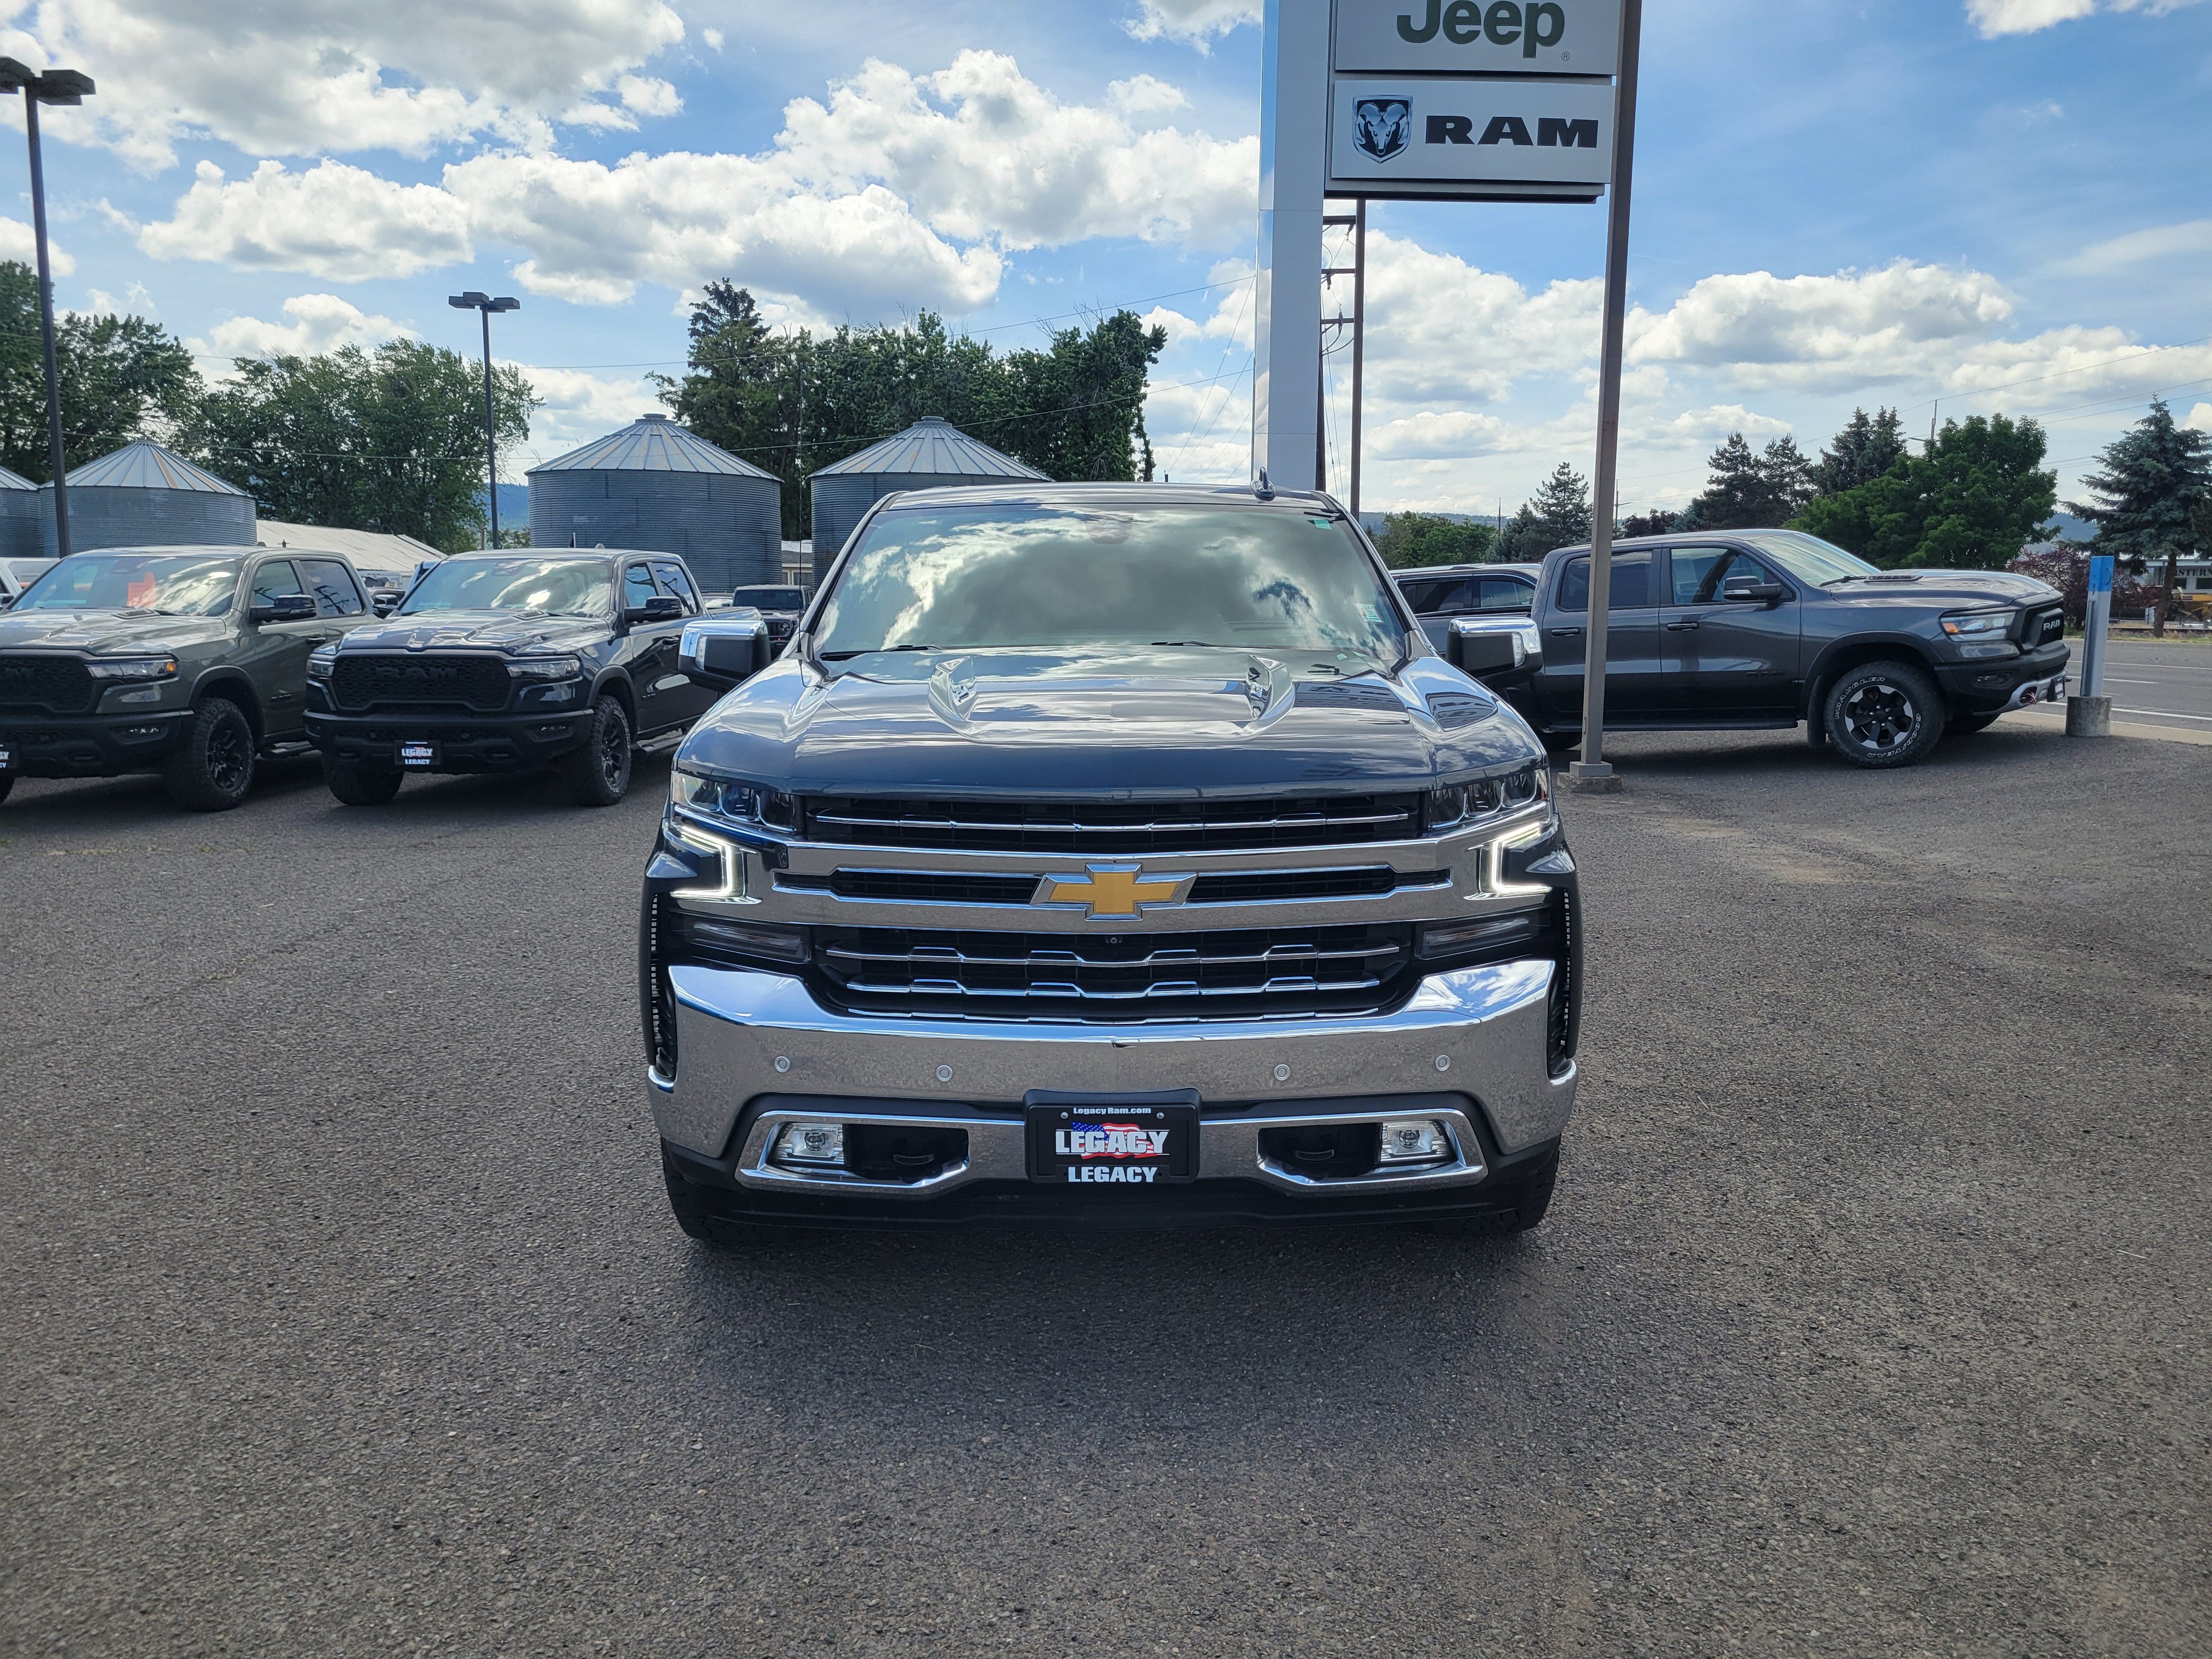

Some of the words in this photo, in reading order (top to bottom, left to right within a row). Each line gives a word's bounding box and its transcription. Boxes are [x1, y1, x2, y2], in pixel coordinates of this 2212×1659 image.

[1397, 0, 1565, 58] Jeep
[1425, 115, 1599, 149] RAM
[1835, 676, 1886, 720] WRANGLER
[401, 748, 433, 757] LEGACY
[1055, 1131, 1169, 1153] LEGACY
[1068, 1166, 1158, 1183] LEGACY
